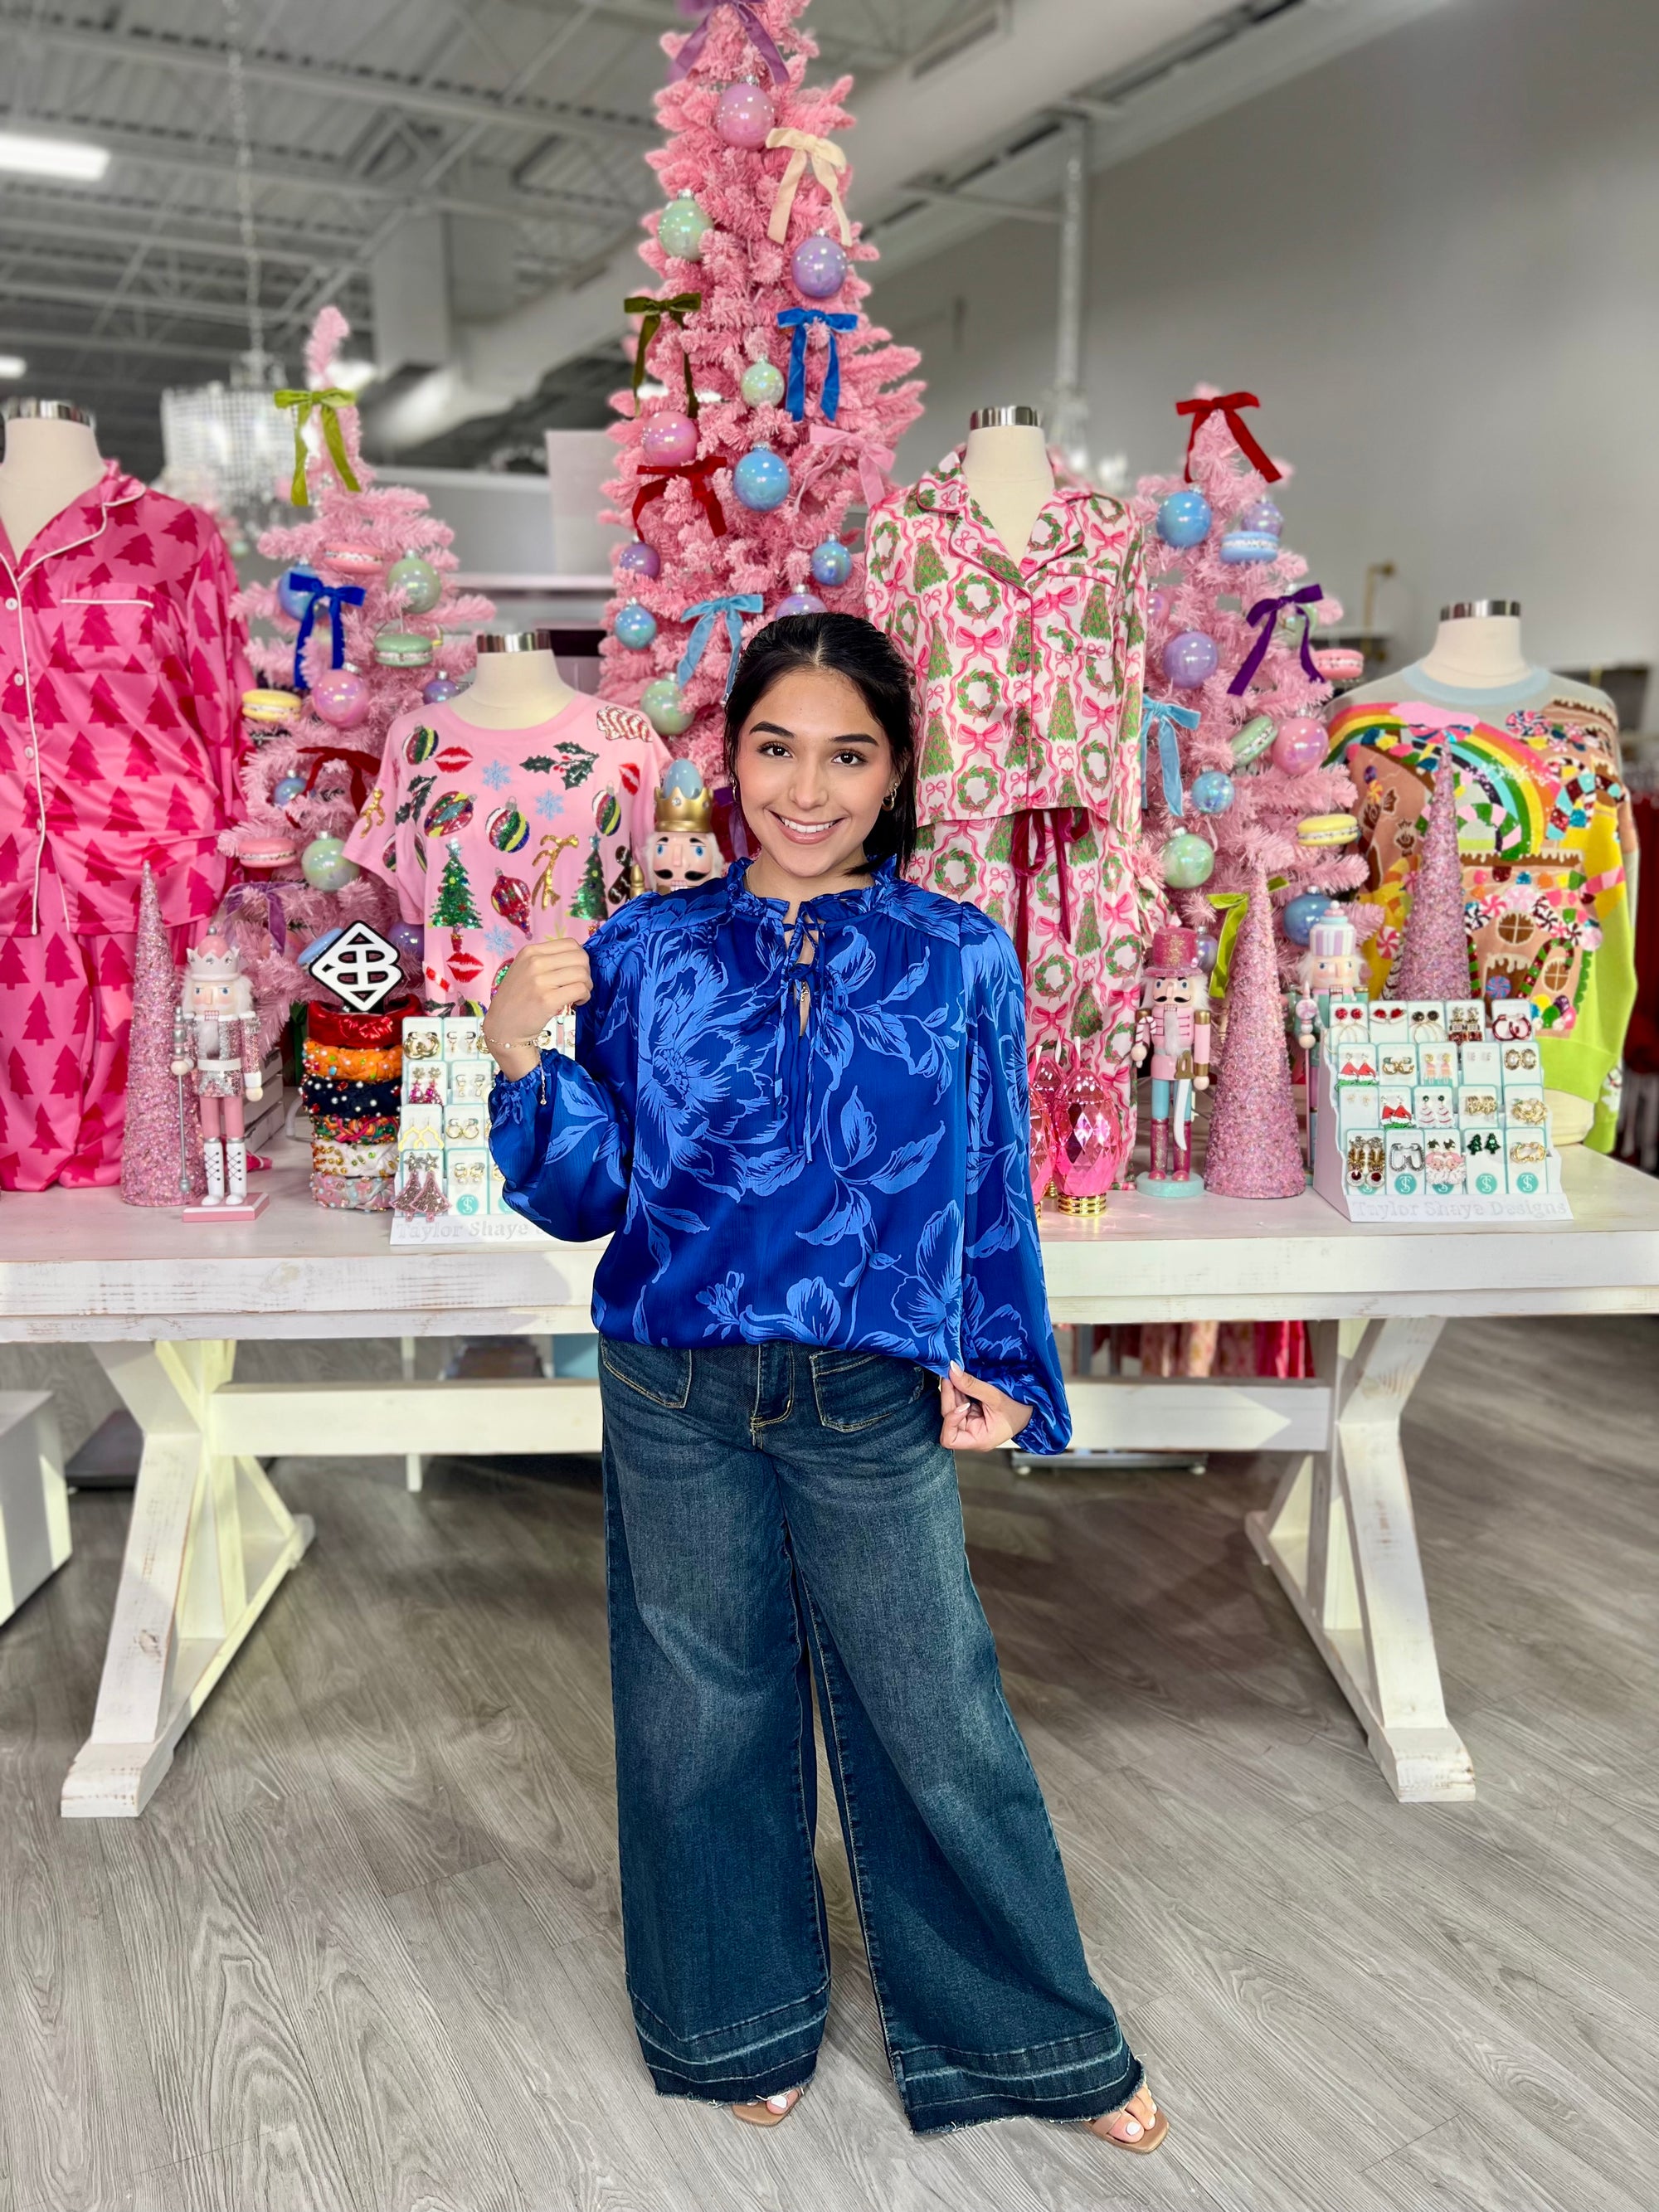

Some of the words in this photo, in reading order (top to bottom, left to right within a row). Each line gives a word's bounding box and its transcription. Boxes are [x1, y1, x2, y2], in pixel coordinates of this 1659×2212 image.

[1352, 1200, 1419, 1220] Taylor
[1424, 1200, 1485, 1219] Shaye
[1488, 1199, 1568, 1219] Designs
[397, 1221, 464, 1242] Taylor
[469, 1220, 528, 1241] Shaye
